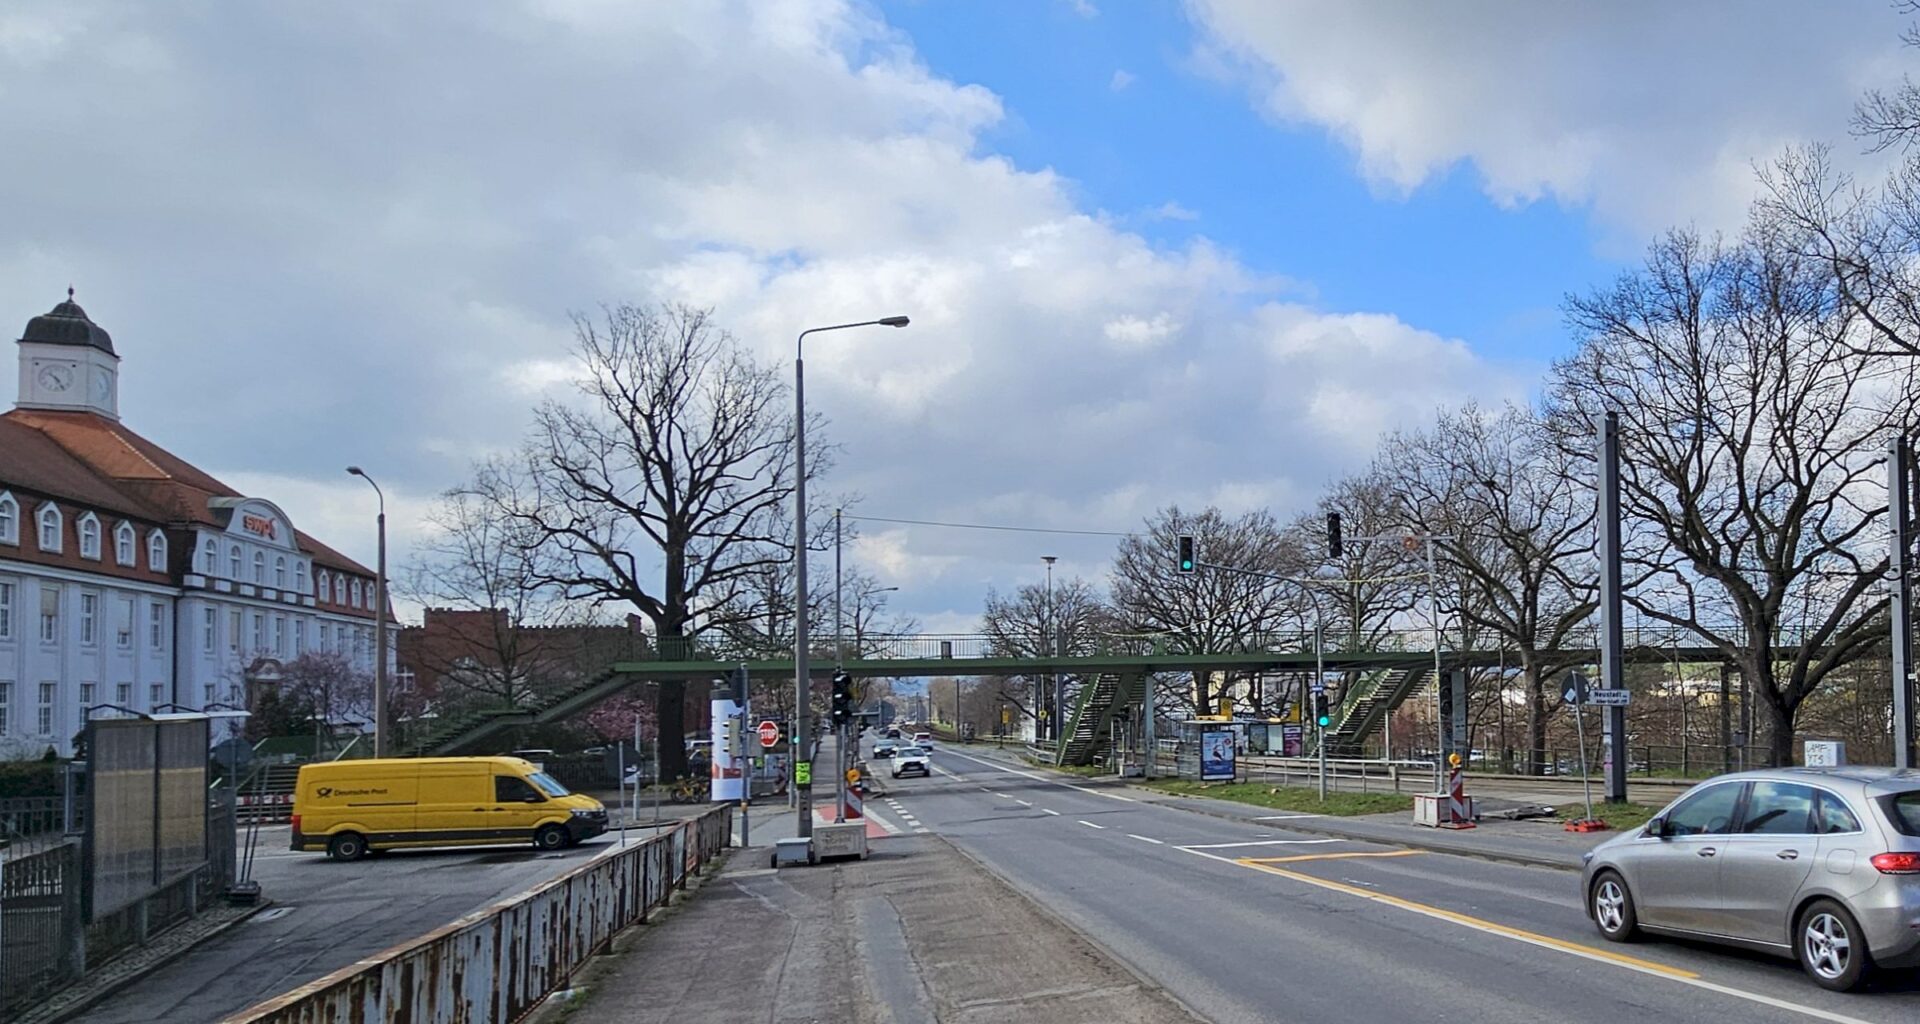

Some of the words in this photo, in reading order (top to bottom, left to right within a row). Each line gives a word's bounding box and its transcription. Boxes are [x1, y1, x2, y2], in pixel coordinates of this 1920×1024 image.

[760, 728, 776, 740] STOP
[334, 788, 369, 797] Deutsche
[371, 788, 388, 796] Post
